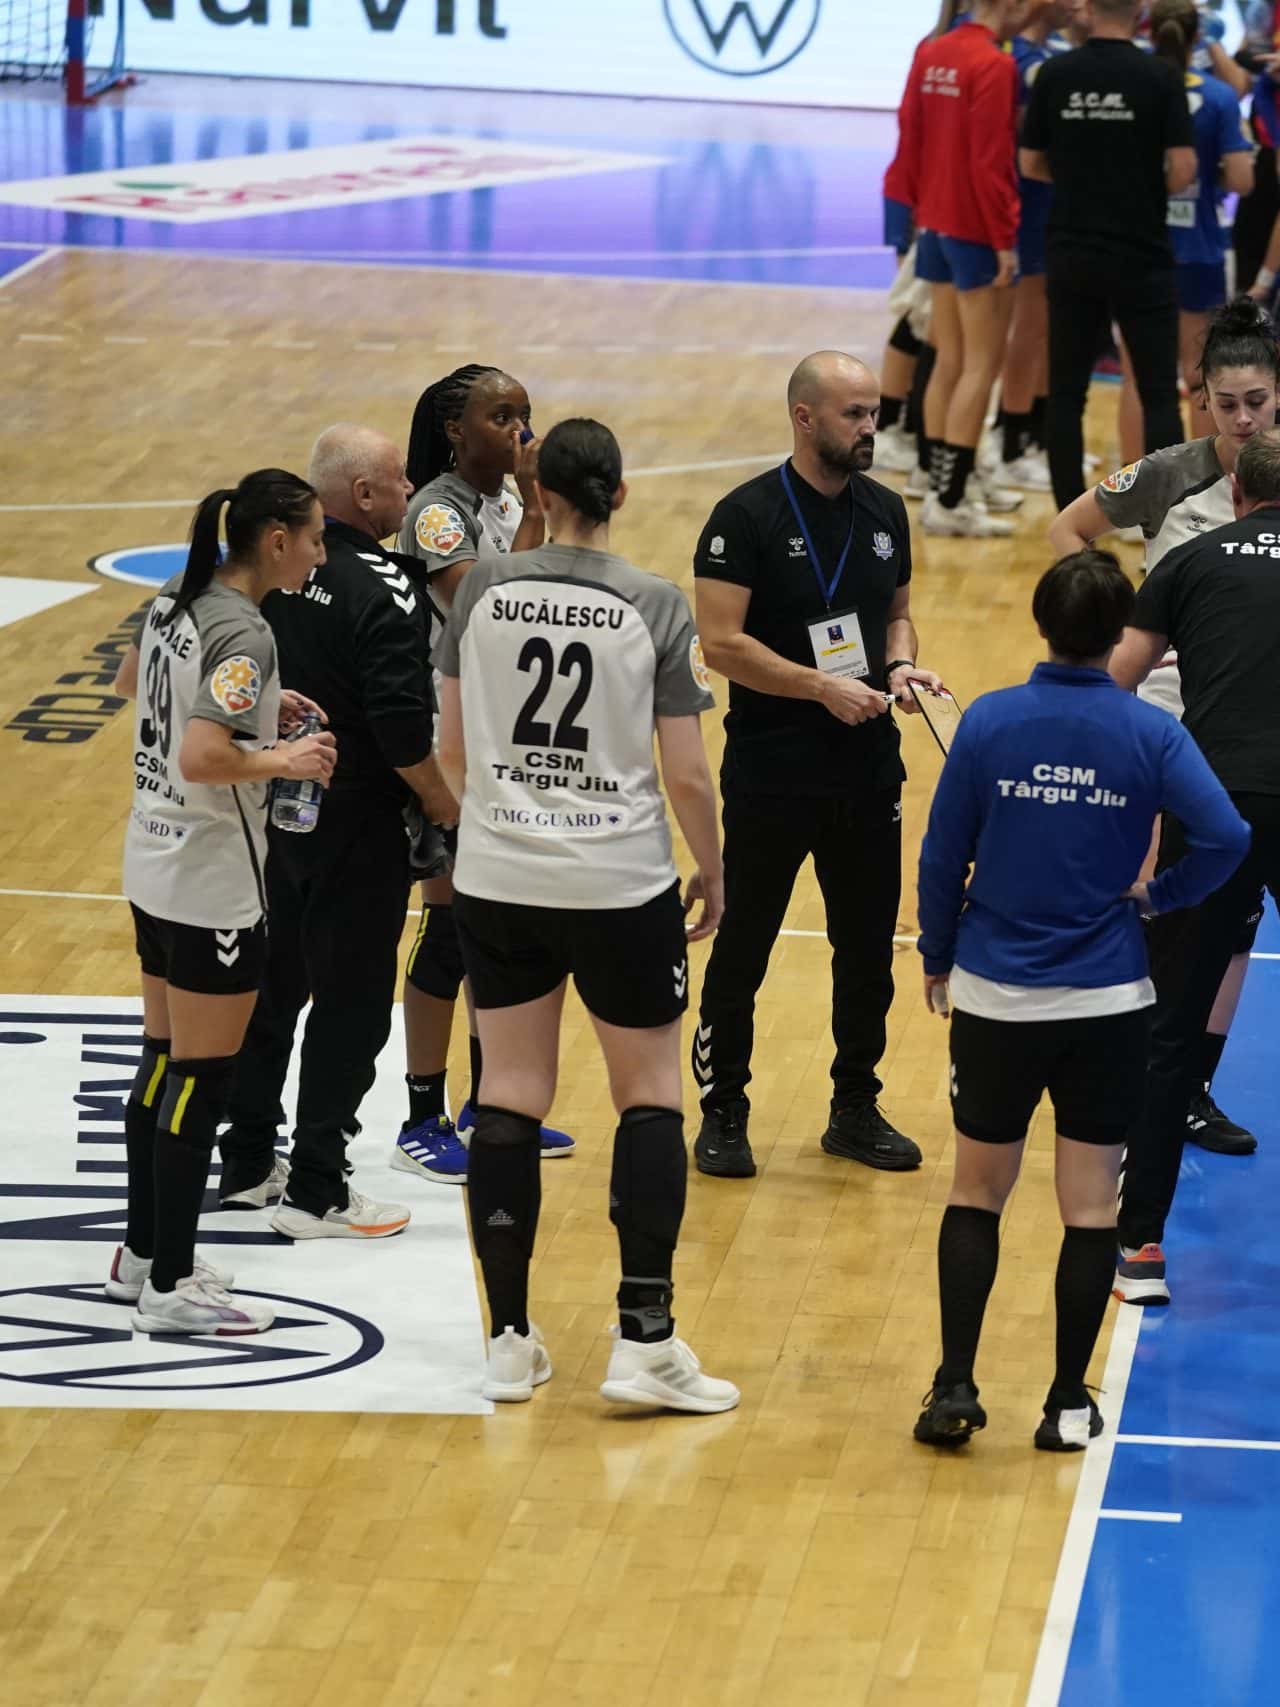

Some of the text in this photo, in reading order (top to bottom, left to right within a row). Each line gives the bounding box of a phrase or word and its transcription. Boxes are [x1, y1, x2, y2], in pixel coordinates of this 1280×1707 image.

[305, 585, 332, 605] Jiu
[491, 598, 624, 630] SUCĂLESCU
[512, 636, 593, 753] 22
[134, 752, 168, 781] CSM
[525, 752, 584, 773] CSM
[1033, 764, 1096, 786] CSM
[492, 763, 619, 793] Târgu Jiu
[997, 780, 1127, 807] Târgu Jiu
[491, 807, 601, 827] TMG GUARD
